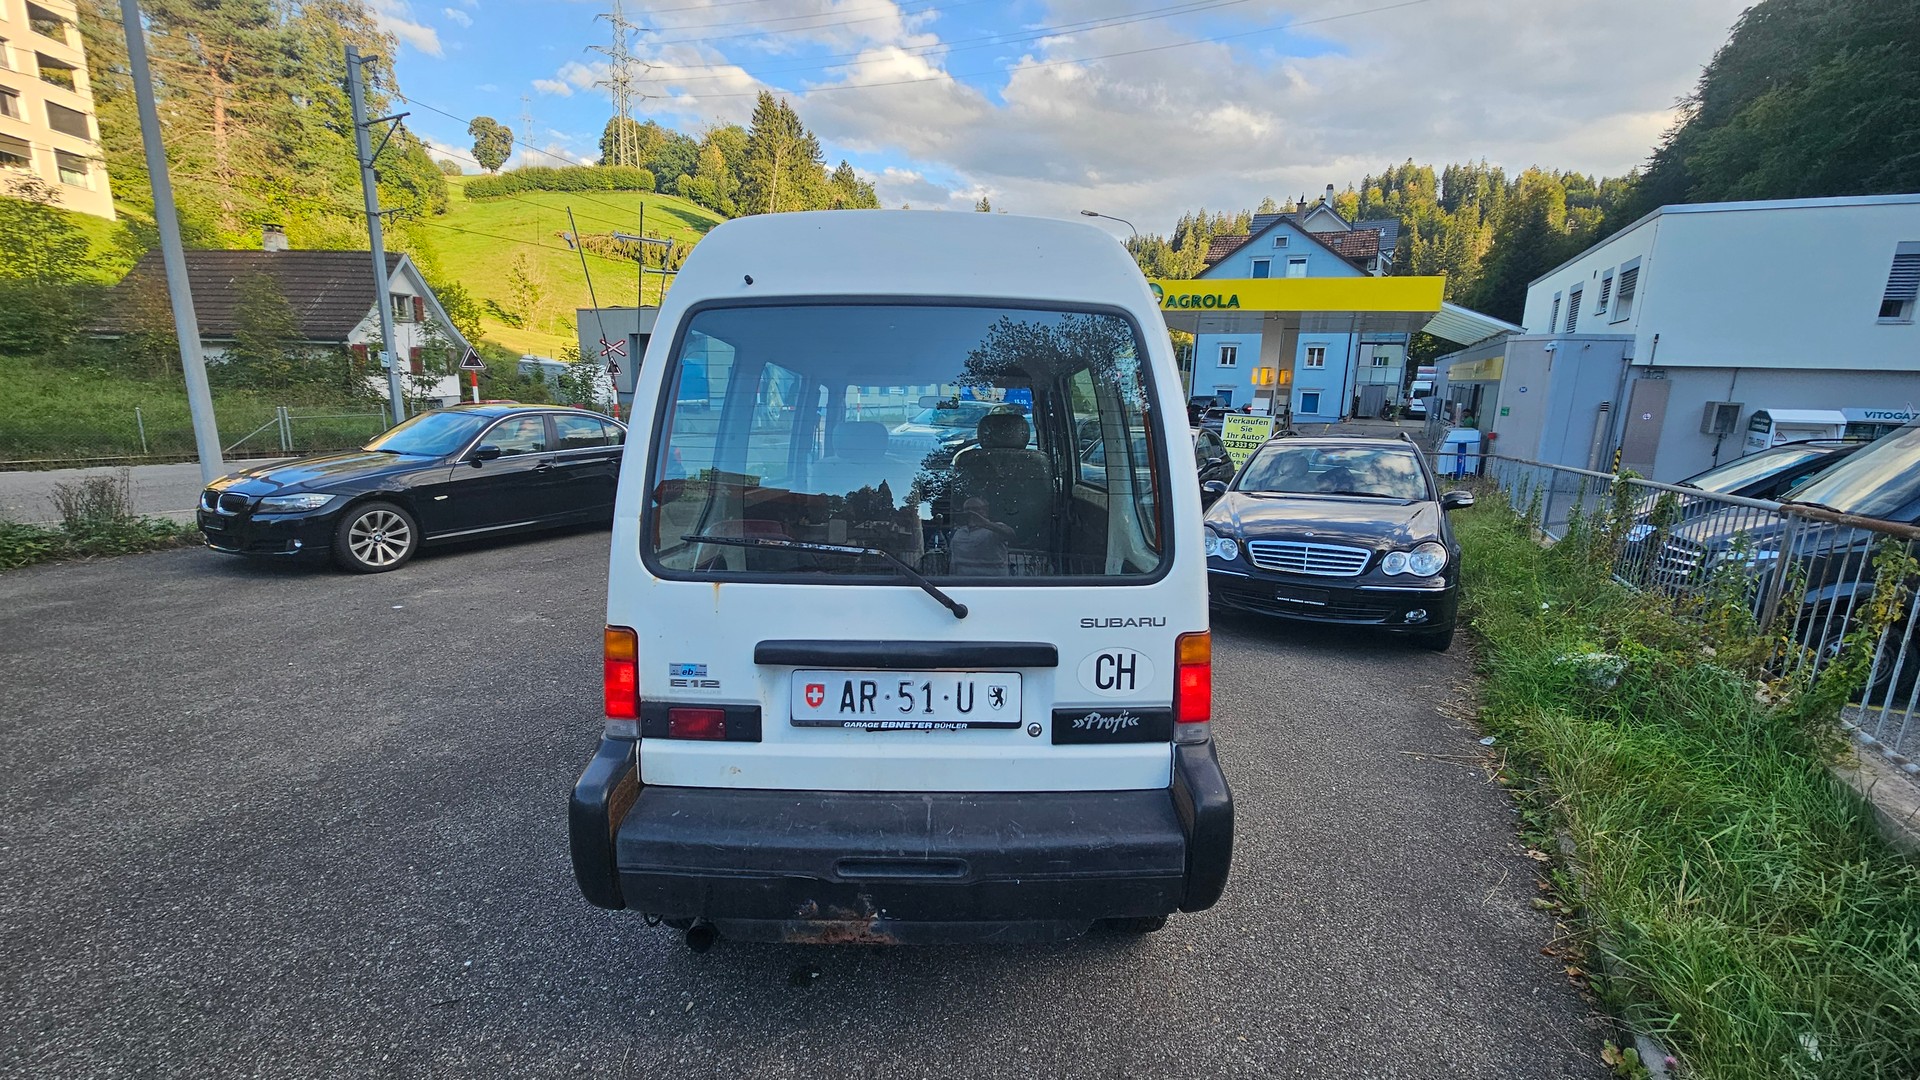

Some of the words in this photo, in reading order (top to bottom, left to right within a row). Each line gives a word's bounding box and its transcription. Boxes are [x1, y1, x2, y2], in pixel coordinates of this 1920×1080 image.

[1165, 294, 1240, 309] AGROLA
[1228, 417, 1269, 426] Verkaufen
[1080, 616, 1167, 629] SUBARU
[682, 668, 694, 676] eb
[1095, 653, 1137, 690] CH
[670, 679, 721, 689] E12
[844, 721, 880, 729] GARAGE
[881, 721, 933, 729] EBNETER
[934, 721, 968, 729] BÜHLER
